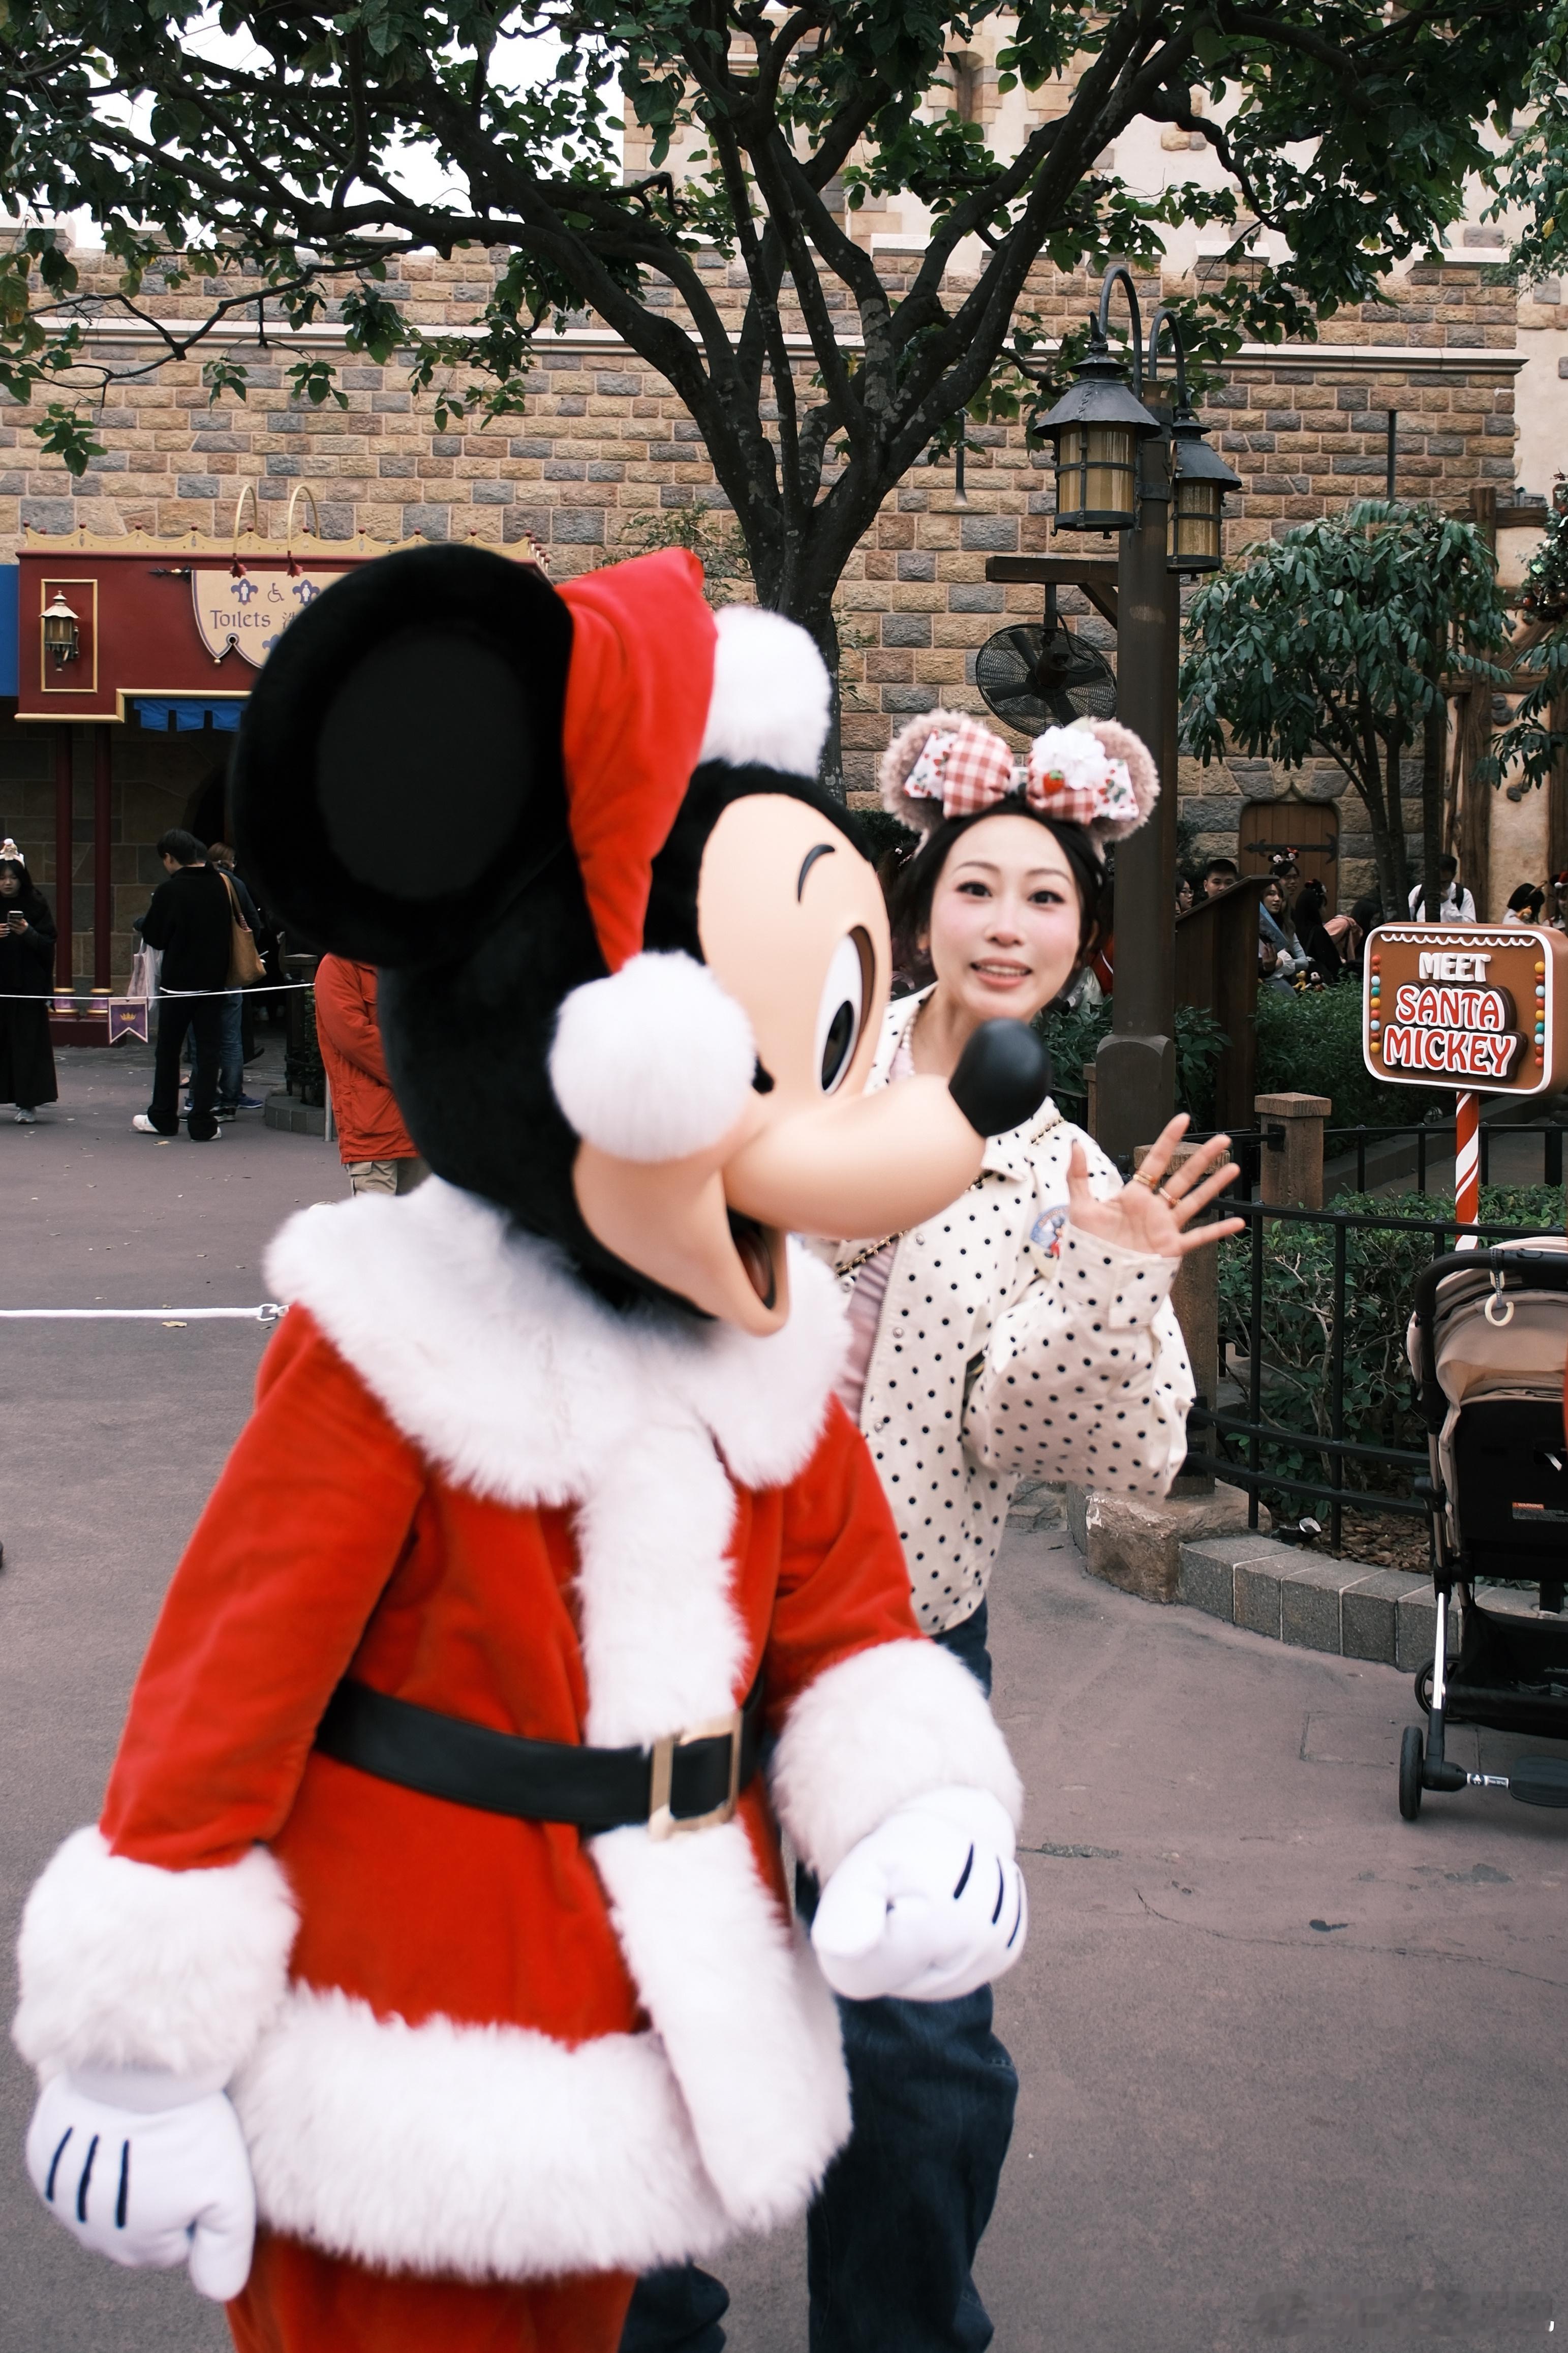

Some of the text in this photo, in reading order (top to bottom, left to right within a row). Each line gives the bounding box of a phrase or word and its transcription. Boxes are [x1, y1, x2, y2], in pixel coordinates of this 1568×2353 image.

[210, 610, 270, 629] Toilets
[1419, 952, 1491, 982] MEET
[1396, 985, 1505, 1032] SANTA
[1384, 1024, 1517, 1077] MICKEY
